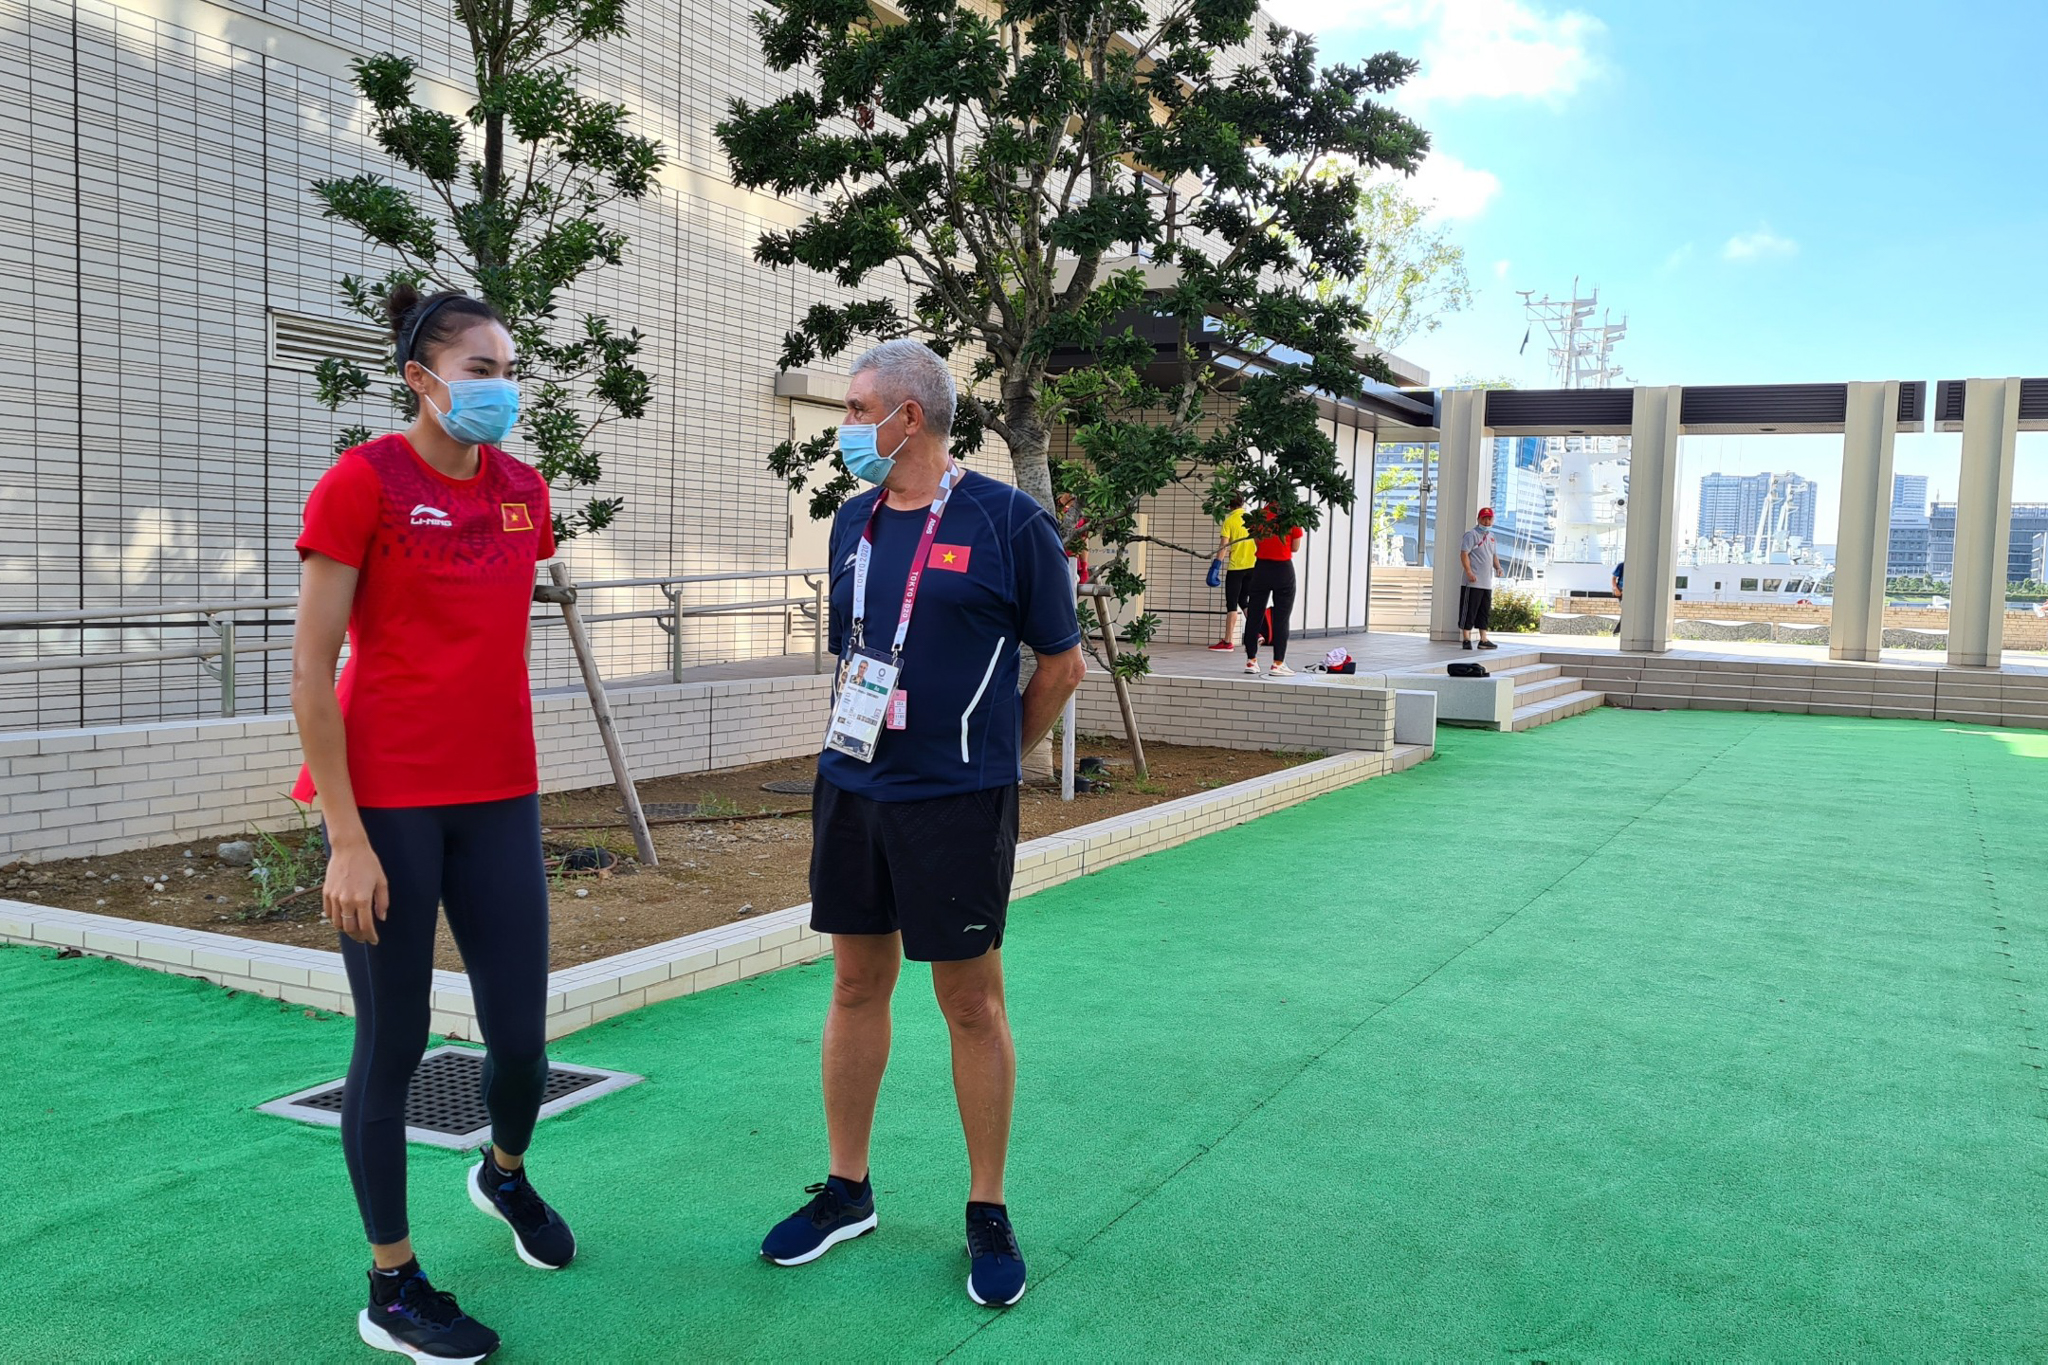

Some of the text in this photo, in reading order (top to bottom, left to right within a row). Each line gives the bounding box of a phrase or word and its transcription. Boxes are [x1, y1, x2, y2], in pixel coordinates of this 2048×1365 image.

[410, 517, 452, 526] LI-NING
[857, 544, 869, 588] TOKYO 2020
[906, 571, 918, 597] TOKYO
[902, 598, 912, 618] 2020
